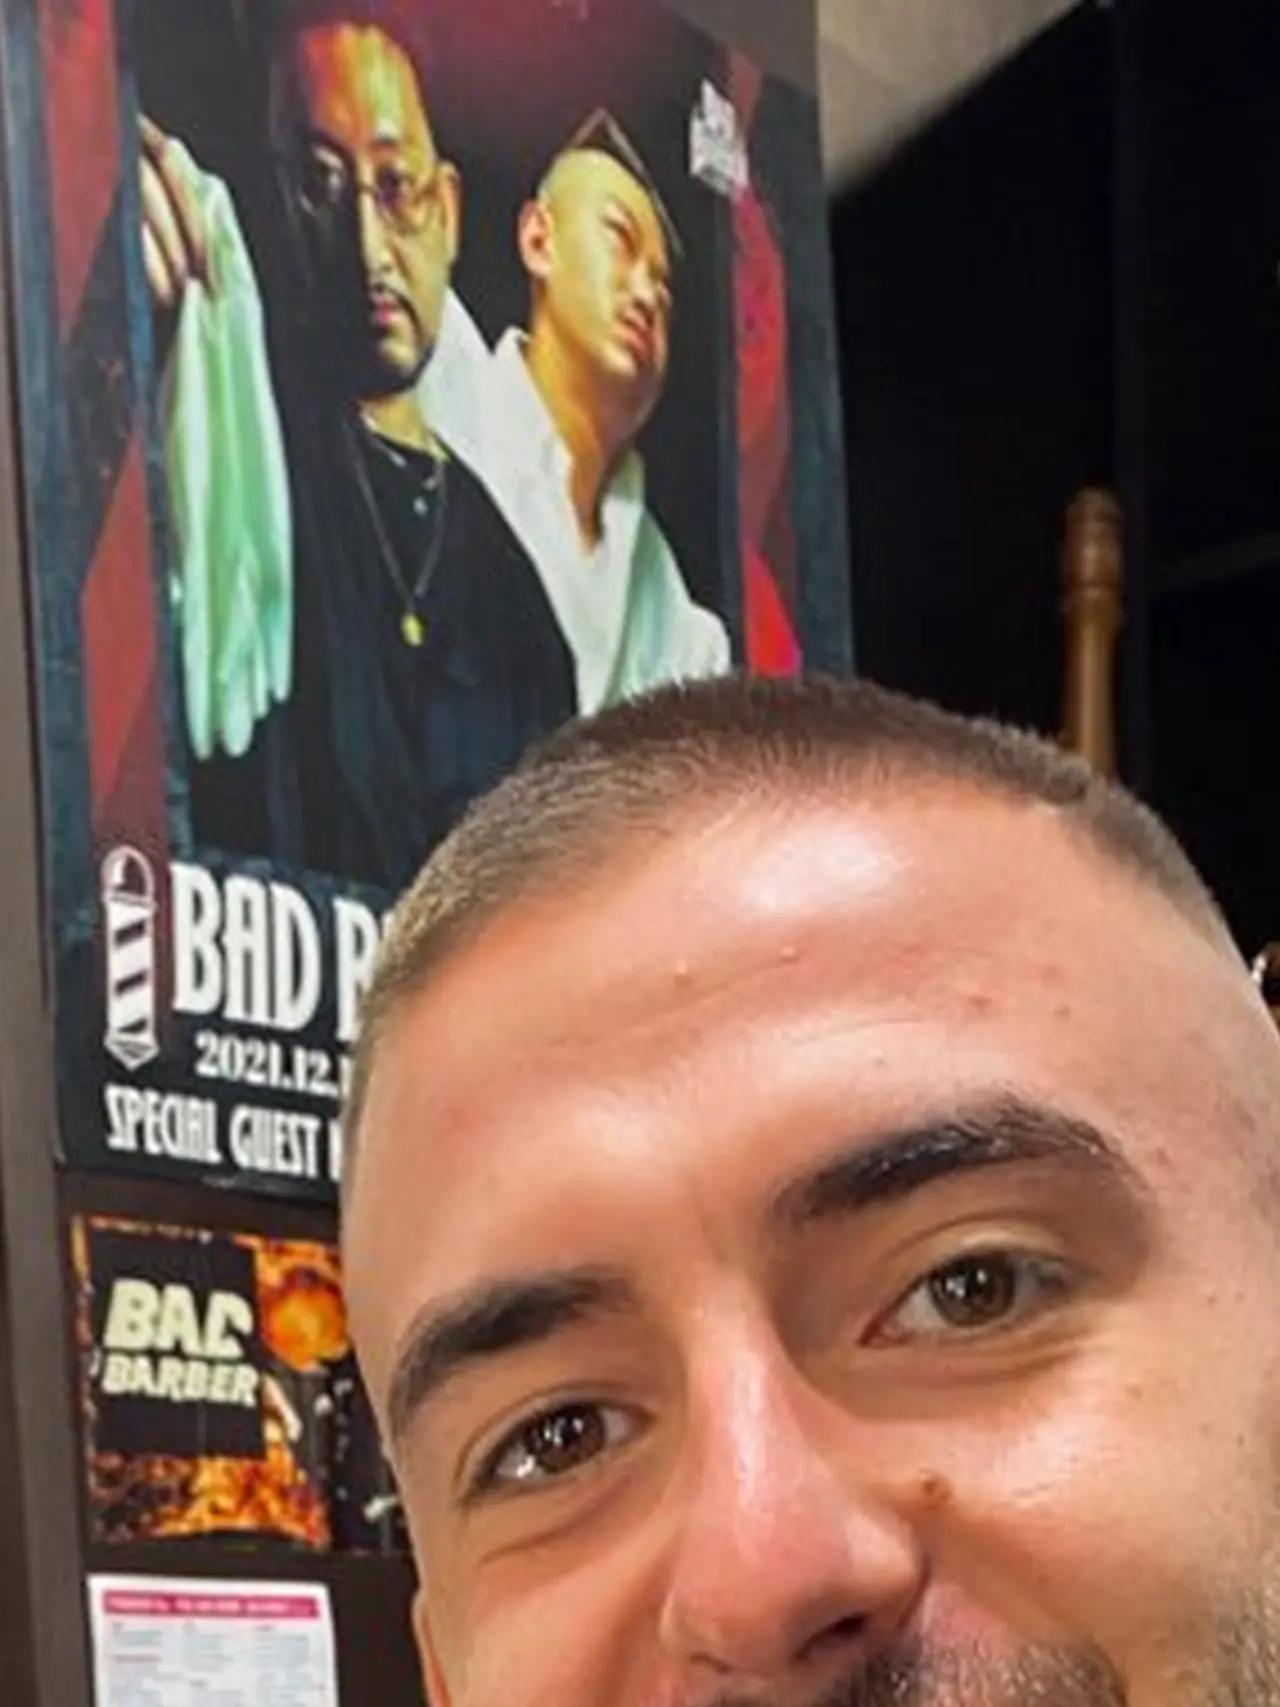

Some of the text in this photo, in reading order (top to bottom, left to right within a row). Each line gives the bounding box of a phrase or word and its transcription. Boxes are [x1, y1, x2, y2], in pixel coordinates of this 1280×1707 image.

[169, 861, 322, 1031] BAD
[104, 1085, 223, 1164] SPECIAL
[229, 1104, 322, 1178] GUEST
[101, 1352, 261, 1408] BARBER
